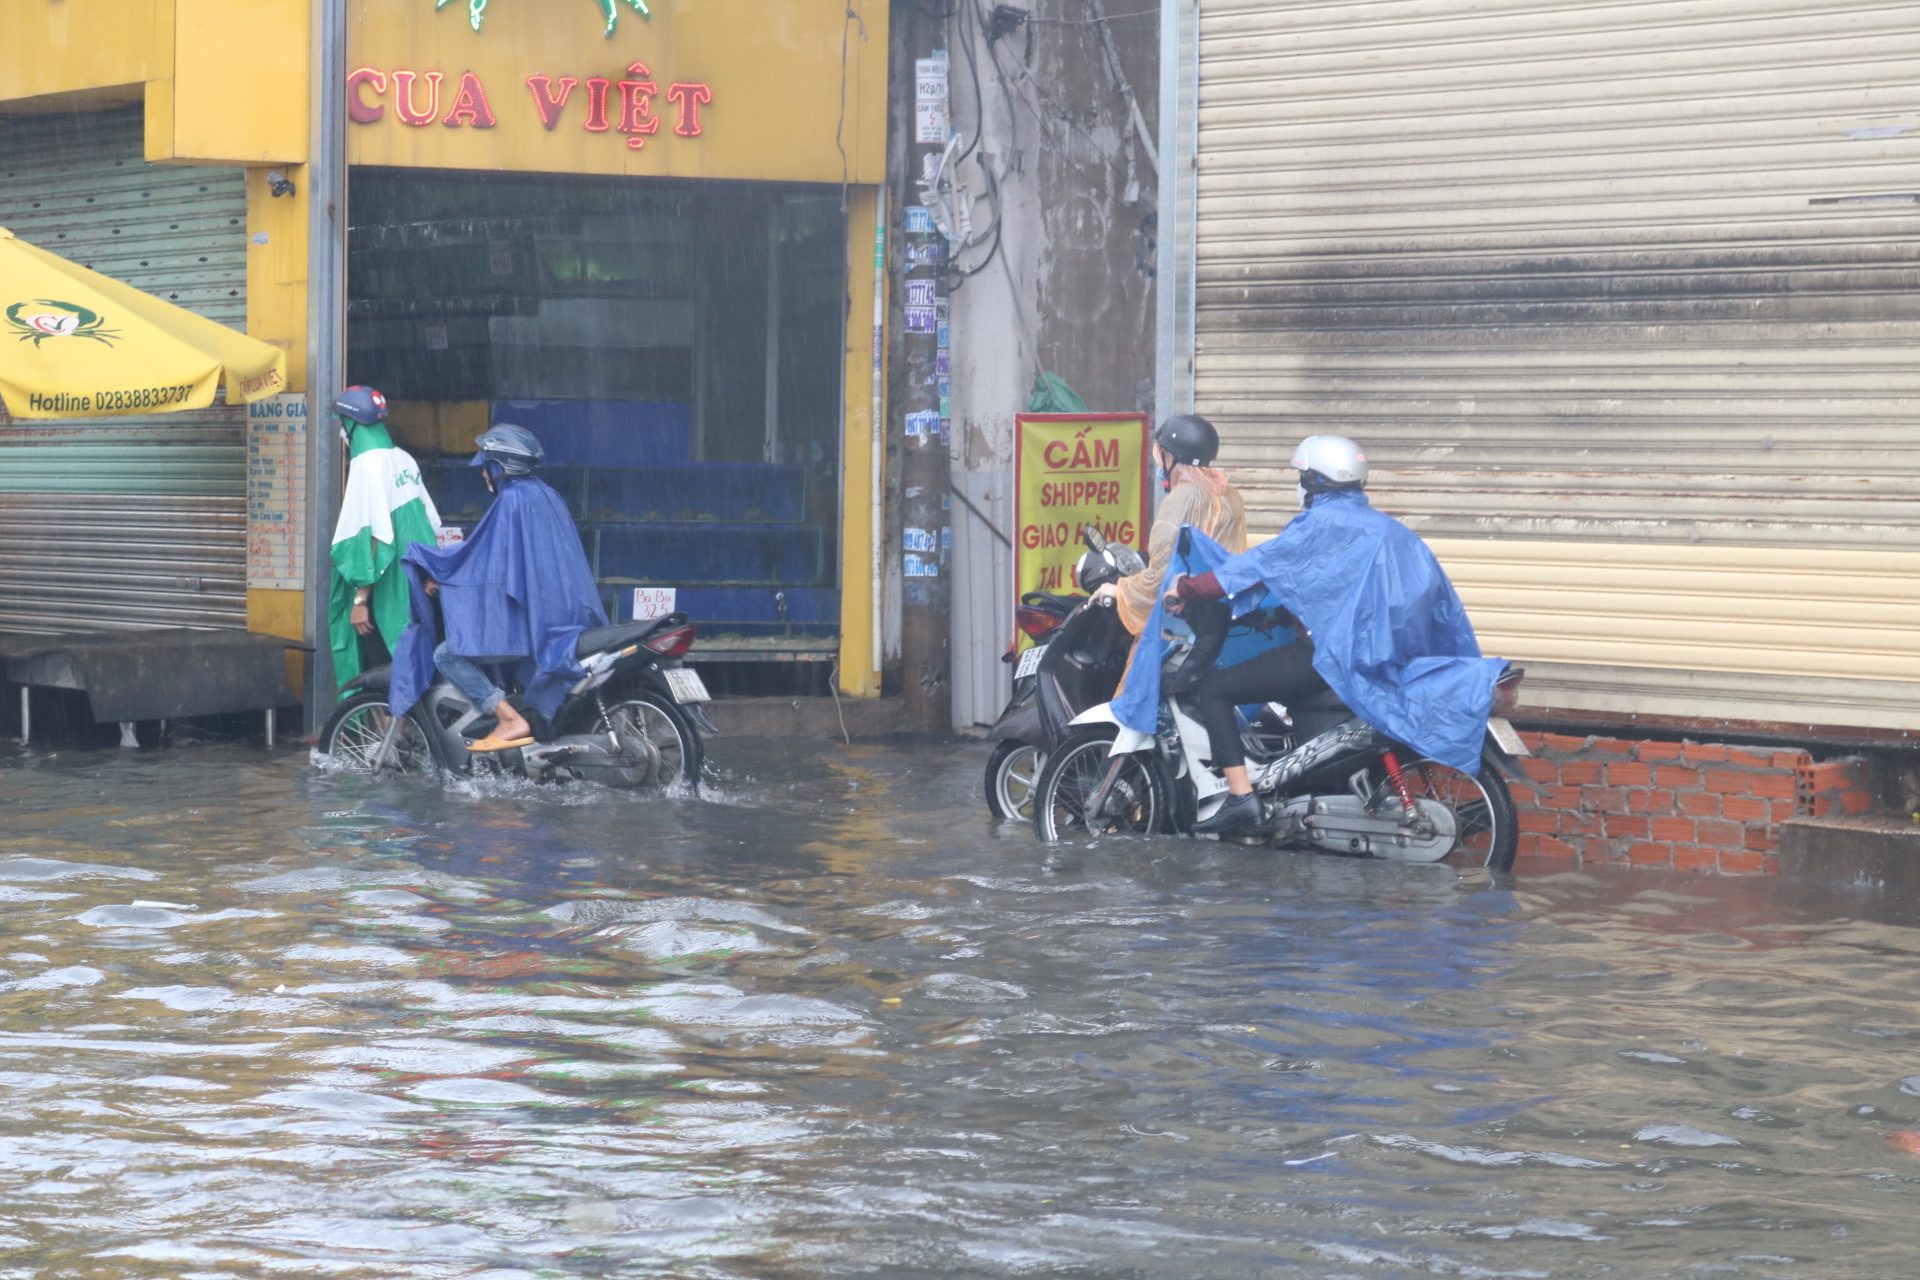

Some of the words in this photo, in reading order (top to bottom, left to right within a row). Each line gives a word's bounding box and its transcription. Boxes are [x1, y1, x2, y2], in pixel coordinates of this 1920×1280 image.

[347, 67, 496, 131] CUA
[526, 61, 712, 150] VIỆT
[30, 393, 90, 412] Hotline
[96, 384, 194, 410] 02838833737
[286, 399, 308, 418] GIÁ
[1043, 426, 1119, 470] CẤM
[1040, 481, 1120, 508] SHIPPER
[1022, 522, 1069, 550] GIAO
[636, 589, 652, 604] Ba
[655, 589, 671, 604] Ba
